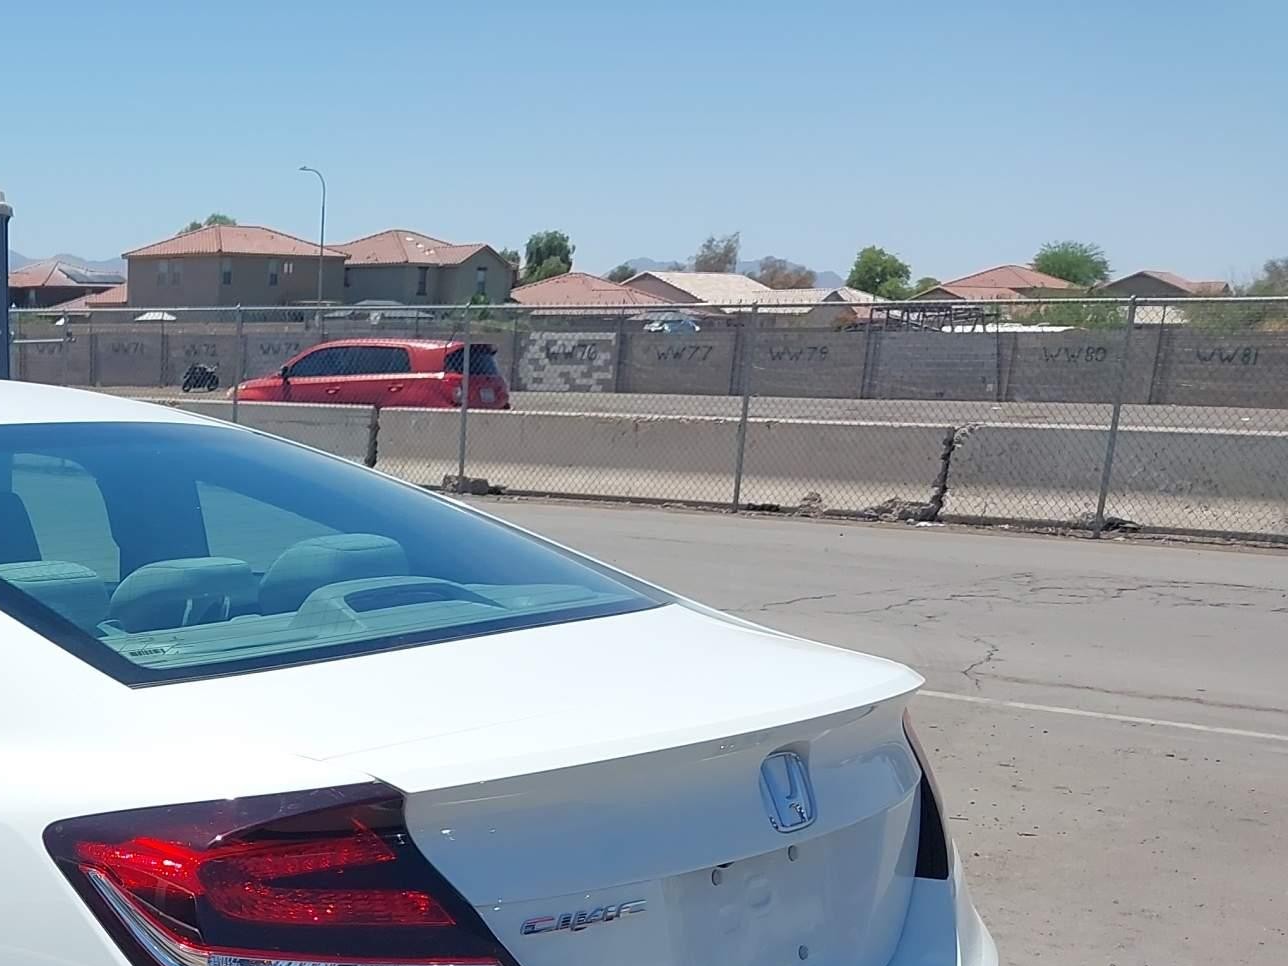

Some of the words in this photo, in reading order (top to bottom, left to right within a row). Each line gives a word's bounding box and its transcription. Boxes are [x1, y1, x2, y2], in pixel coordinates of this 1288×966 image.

[547, 343, 599, 361] WW76
[656, 345, 713, 361] WW77
[1042, 346, 1107, 363] WW80
[1196, 346, 1259, 366] WW81
